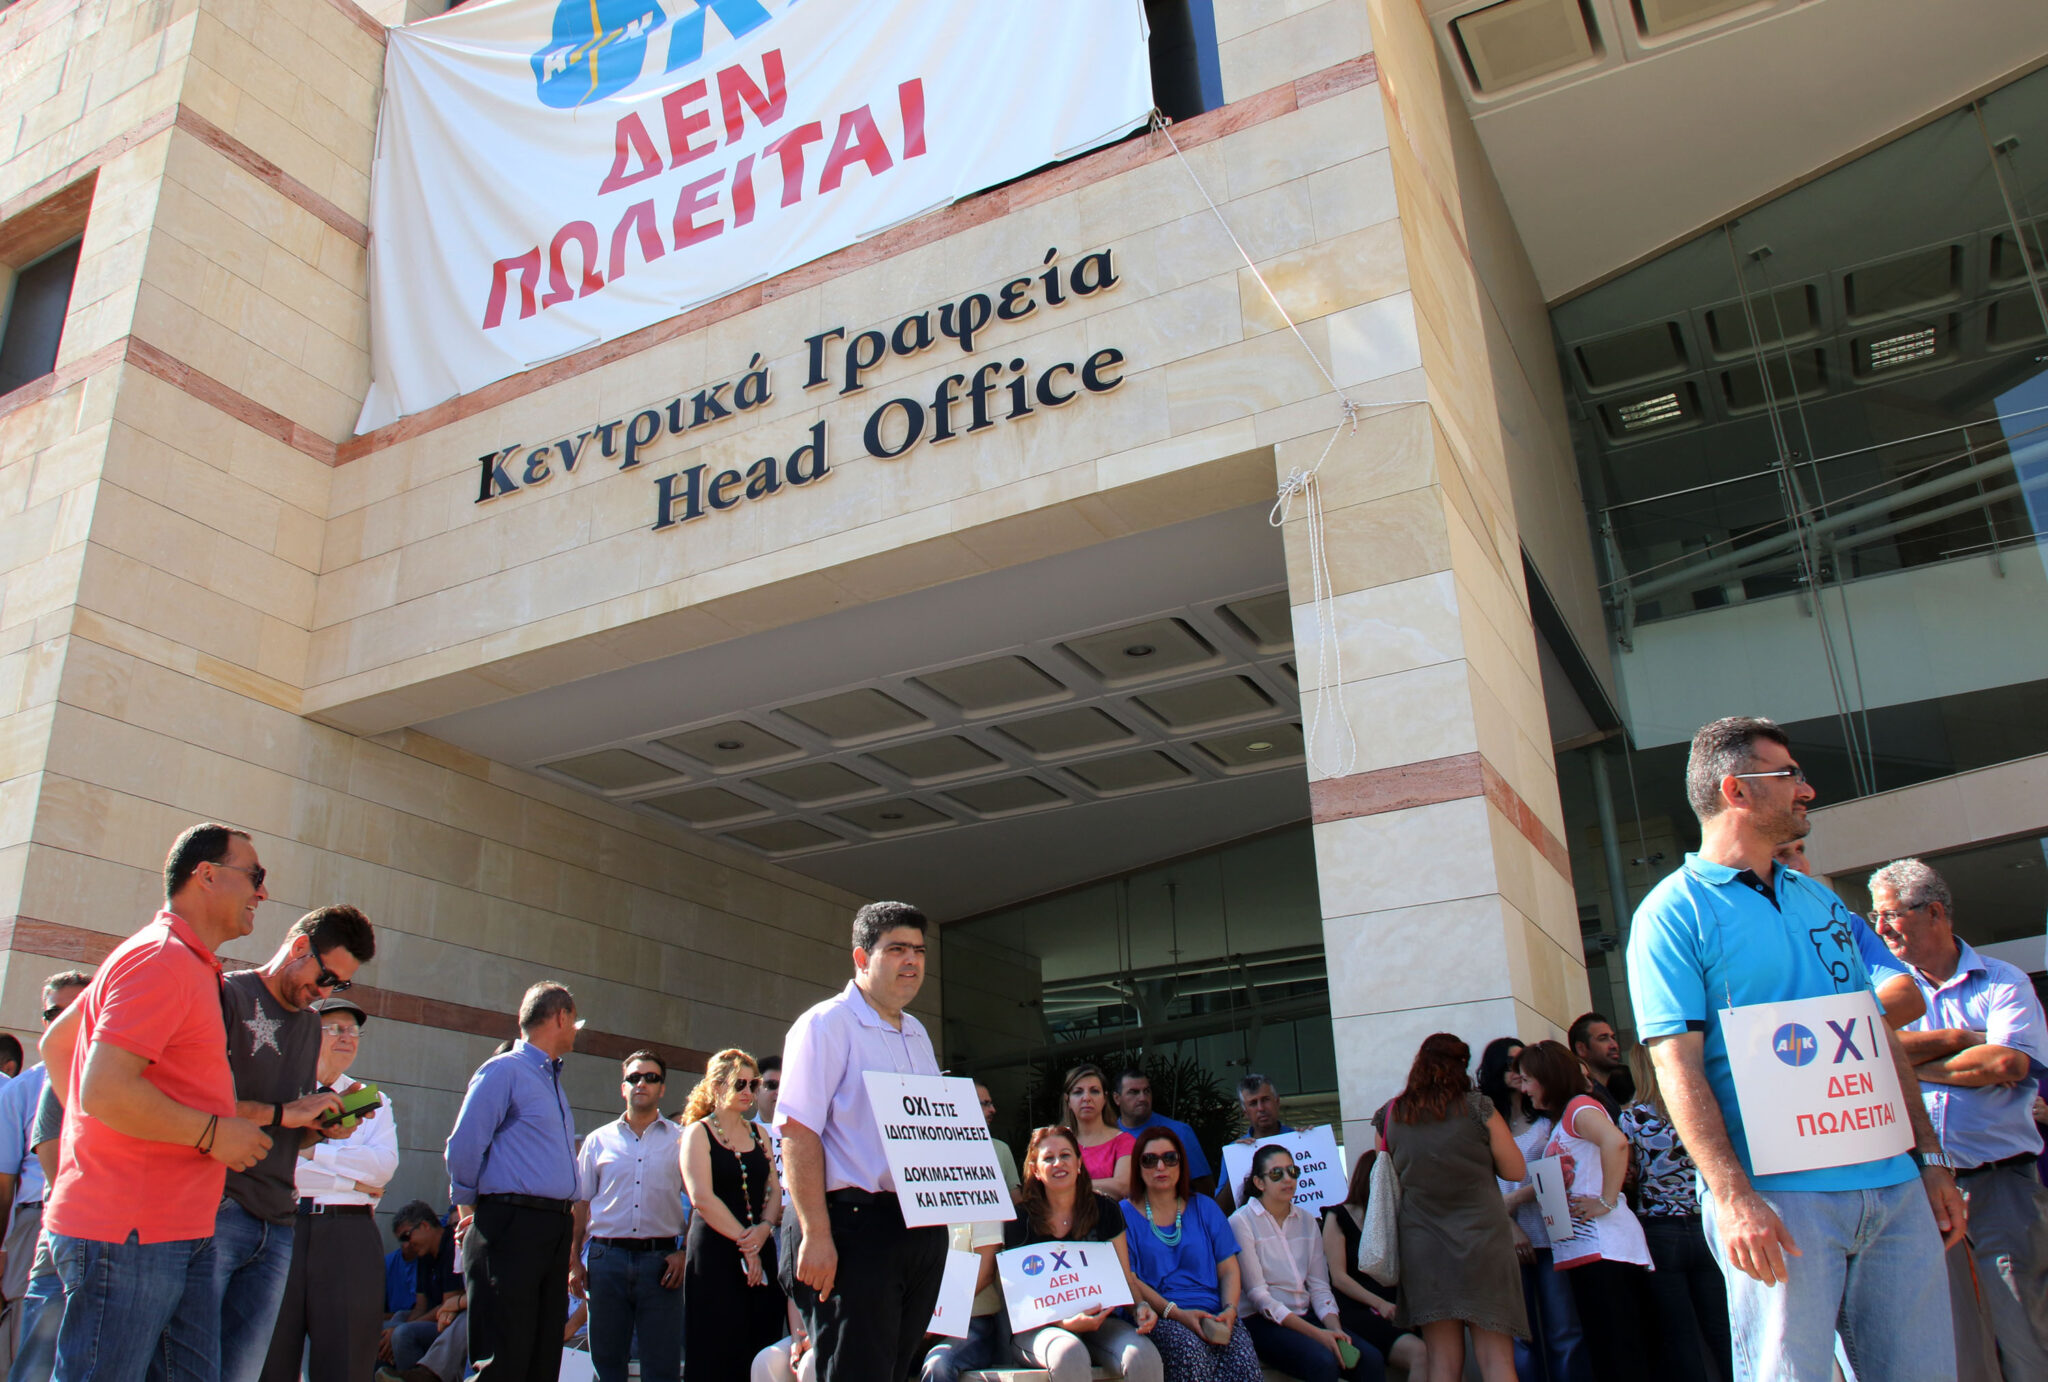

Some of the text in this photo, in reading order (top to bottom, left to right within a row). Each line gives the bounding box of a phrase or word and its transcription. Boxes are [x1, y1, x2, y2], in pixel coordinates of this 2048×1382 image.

[598, 48, 787, 196] ΔΕΝ
[482, 77, 926, 330] ΠΩΛΕΙΤΑΙ
[474, 247, 1120, 504] Κεντρικά Γραφεία
[652, 347, 1127, 531] Head Office
[1827, 1072, 1873, 1098] ΔΕΝ
[902, 1096, 958, 1117] ΟΧΙ ΣΤΙΣ
[1796, 1102, 1896, 1137] ΠΩΛΕΙΤΑΙ
[884, 1125, 988, 1141] ΙΔΙΩΤΙΚΟΠΟΙΗΣΕΙΣ
[1295, 1150, 1311, 1161] ΘΑ
[904, 1166, 996, 1182] ΔΟΚΙΜΑΣΤΗΚΑΝ
[1303, 1161, 1327, 1173] ΕΝΩ
[1299, 1178, 1315, 1189] ΘΑ
[916, 1190, 999, 1208] ΚΑΙ ΑΠΕΤΥΧΑΝ
[1293, 1190, 1324, 1204] ΖΟΥΝ
[1050, 1272, 1080, 1288] ΔΕΝ
[1034, 1284, 1102, 1310] ΠΩΛΕΙΤΑΙ
